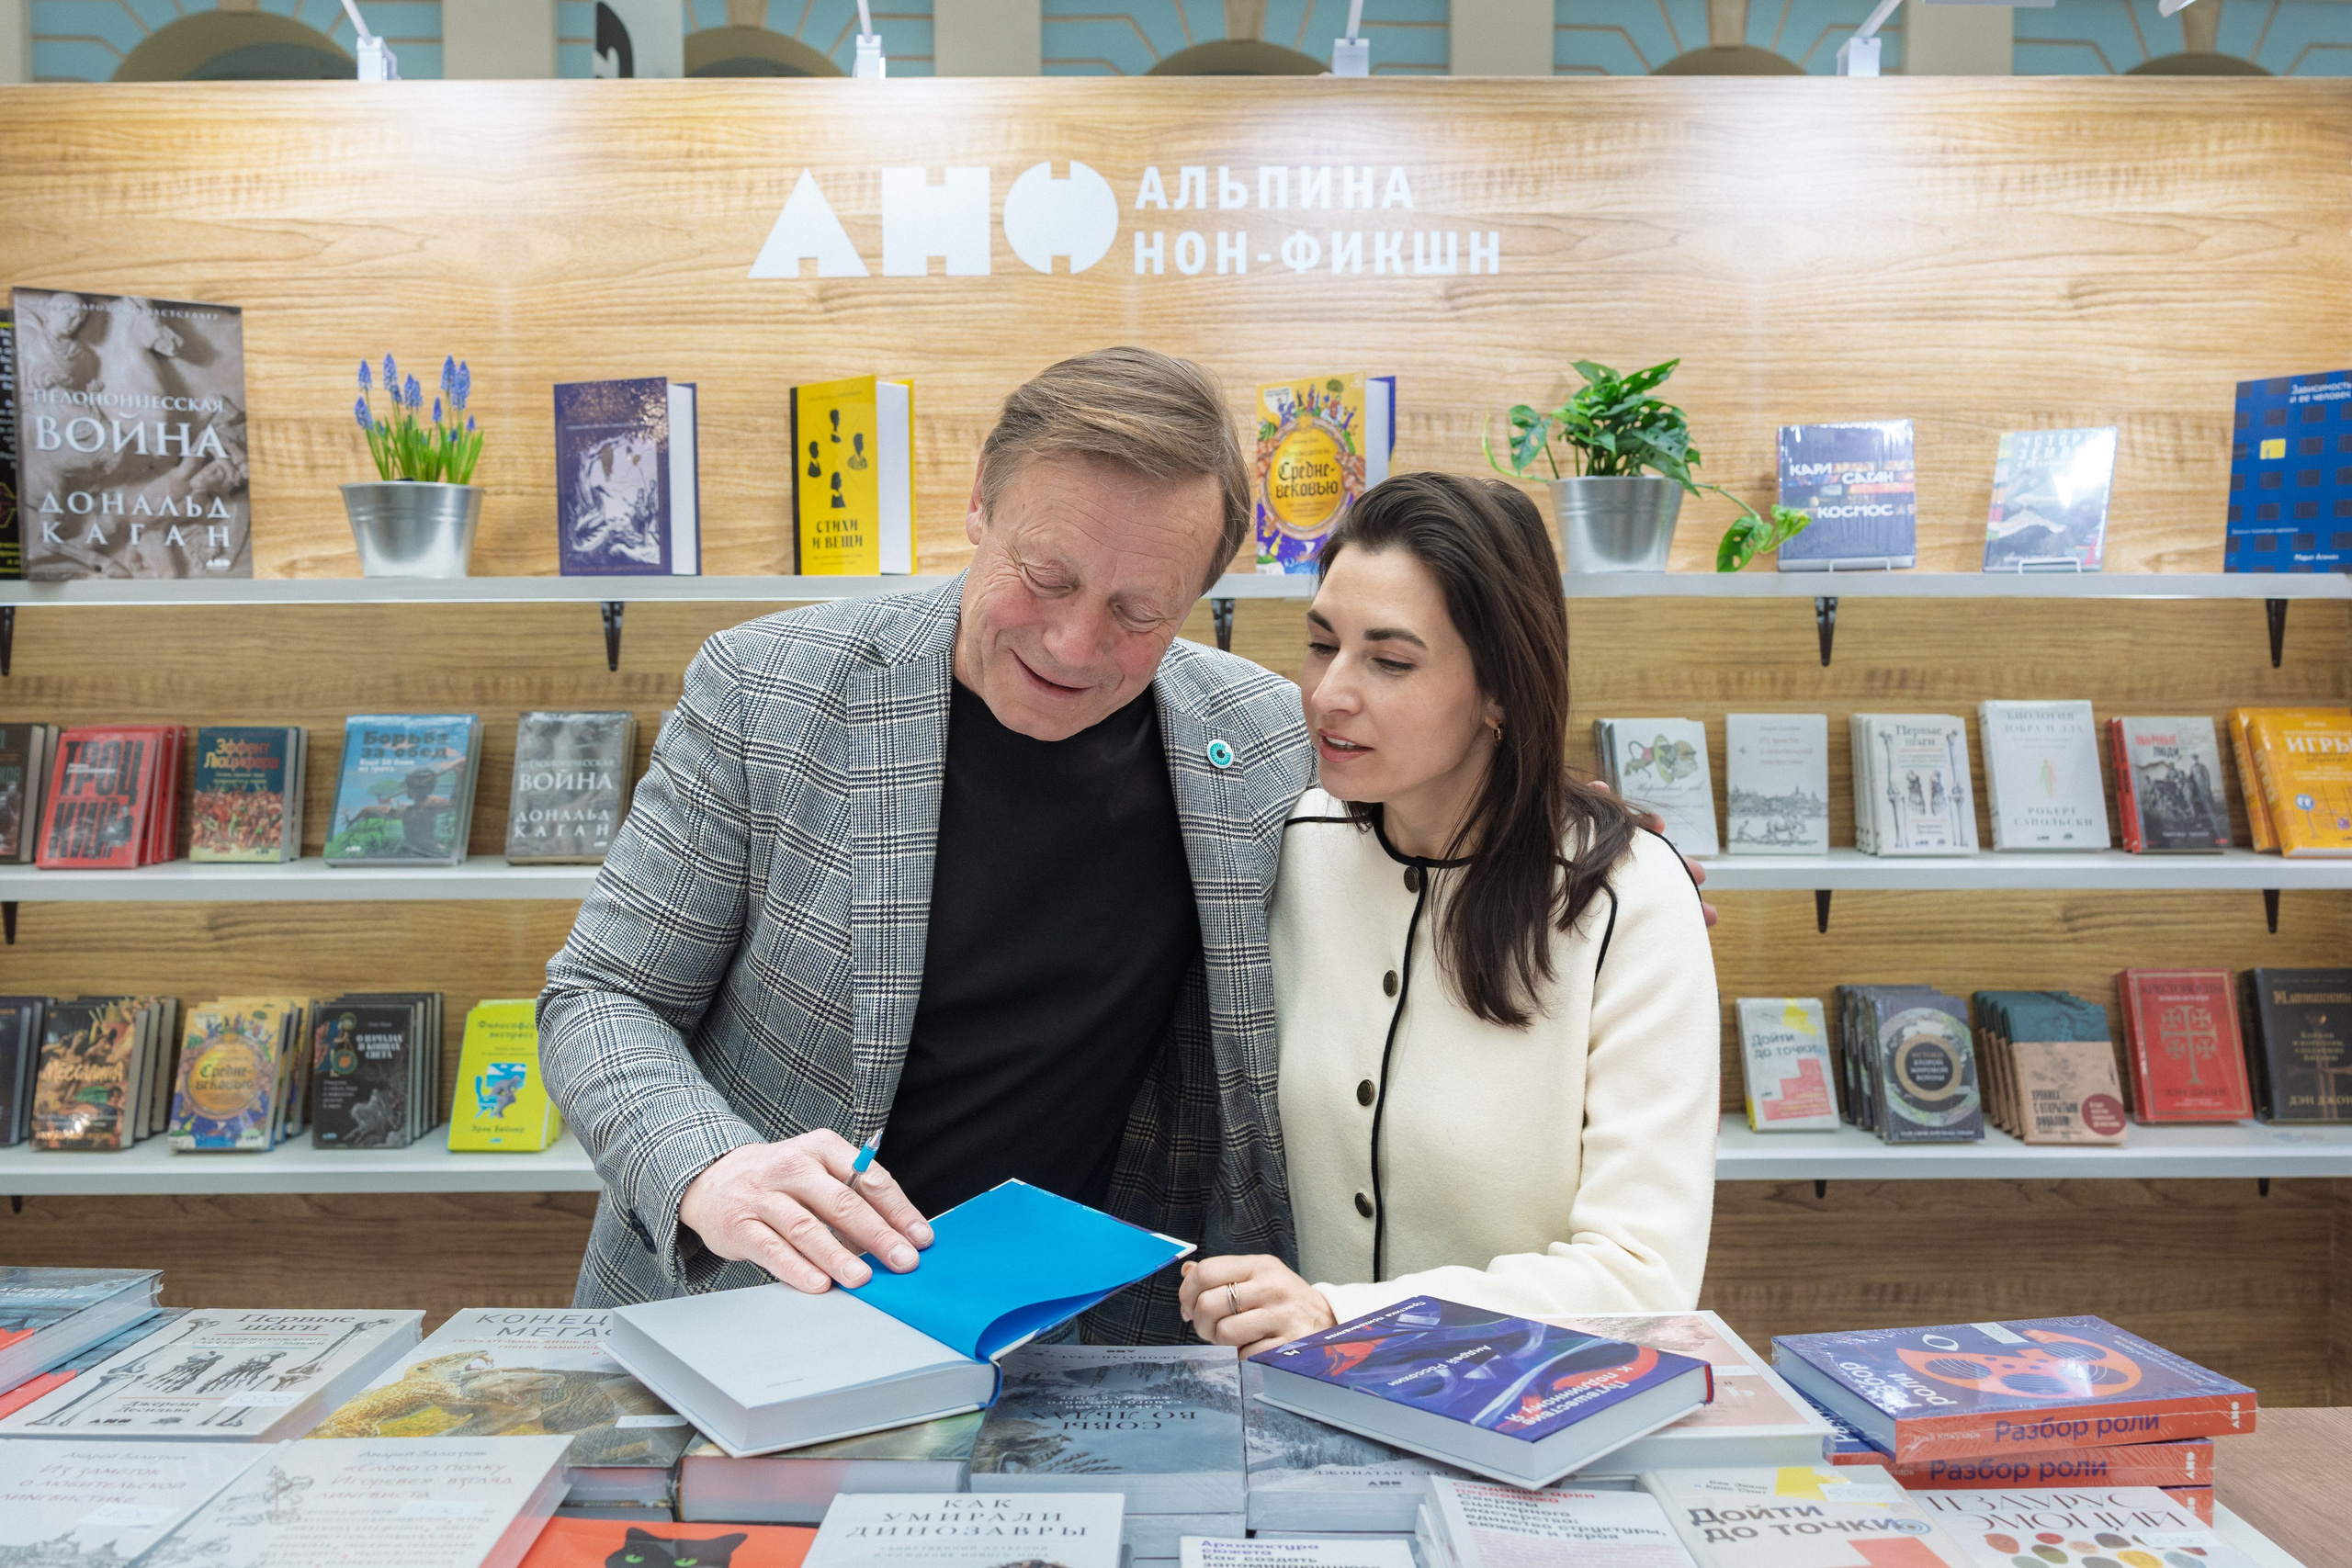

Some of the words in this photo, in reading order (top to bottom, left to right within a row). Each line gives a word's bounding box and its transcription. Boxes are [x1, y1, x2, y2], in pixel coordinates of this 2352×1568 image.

[1135, 164, 1415, 209] АЛЬПИНА
[1133, 230, 1501, 276] НОН-ФИКШН
[2291, 381, 2352, 396] Зависимость
[2312, 391, 2352, 402] человек
[33, 388, 223, 412] ПЕЛОПОННЕССКАЯ
[36, 411, 230, 459] ВОЙНА
[2021, 433, 2081, 447] ИСТОР
[1278, 461, 1335, 484] Средне-
[1789, 462, 1833, 477] КАРЛ
[1841, 471, 1894, 485] САГАН
[1275, 481, 1339, 499] вековью
[39, 491, 231, 518] ДОНАЛЬД
[1817, 504, 1894, 519] КОСМОС
[42, 521, 231, 548] КАГАН
[816, 518, 859, 535] СТИХИ
[824, 535, 864, 549] ВЕЩИ
[2286, 737, 2352, 753] ИГРЫ
[517, 769, 614, 793] ВОЙНА
[514, 809, 610, 823] ДОНАЛЬД
[514, 823, 610, 839] КАГАН
[1751, 1033, 1794, 1047] Дойти
[1385, 1300, 1427, 1320] Практика
[235, 1314, 355, 1325] Первые
[476, 1314, 609, 1325] КОНЕЦ
[241, 1324, 322, 1332] шаги
[1445, 1344, 1492, 1365] Андрей
[1386, 1361, 1449, 1387] Россохин
[1521, 1371, 1615, 1416] подлинному
[1885, 1372, 1958, 1406] роли
[1521, 1380, 1630, 1427] Путешествие
[1029, 1410, 1139, 1420] ЛЬДАХ
[1152, 1411, 1196, 1420] ВО
[1062, 1421, 1162, 1430] СОВЫ
[1996, 1416, 2089, 1441] Разбор
[2098, 1414, 2161, 1438] роли
[1929, 1459, 2030, 1483] Разбор
[2038, 1458, 2109, 1480] роли
[1453, 1481, 1544, 1496] Создание
[1549, 1491, 1596, 1500] арки
[1455, 1488, 1560, 1504] персонажа
[944, 1499, 1012, 1508] КАК
[1457, 1493, 1539, 1508] Секреты
[1461, 1500, 1571, 1517] сценарного
[884, 1513, 1062, 1522] УМИРАЛИ
[1465, 1514, 1553, 1529] единство
[1687, 1504, 1826, 1527] Дойти
[1957, 1509, 2188, 1531] ЭМОЦИЙ
[845, 1526, 1087, 1538] ДИНОЗАВРЫ
[1467, 1520, 1541, 1536] сюжета
[1702, 1526, 1759, 1543] до
[1768, 1517, 1903, 1536] точки
[1201, 1540, 1319, 1551] Архитектура
